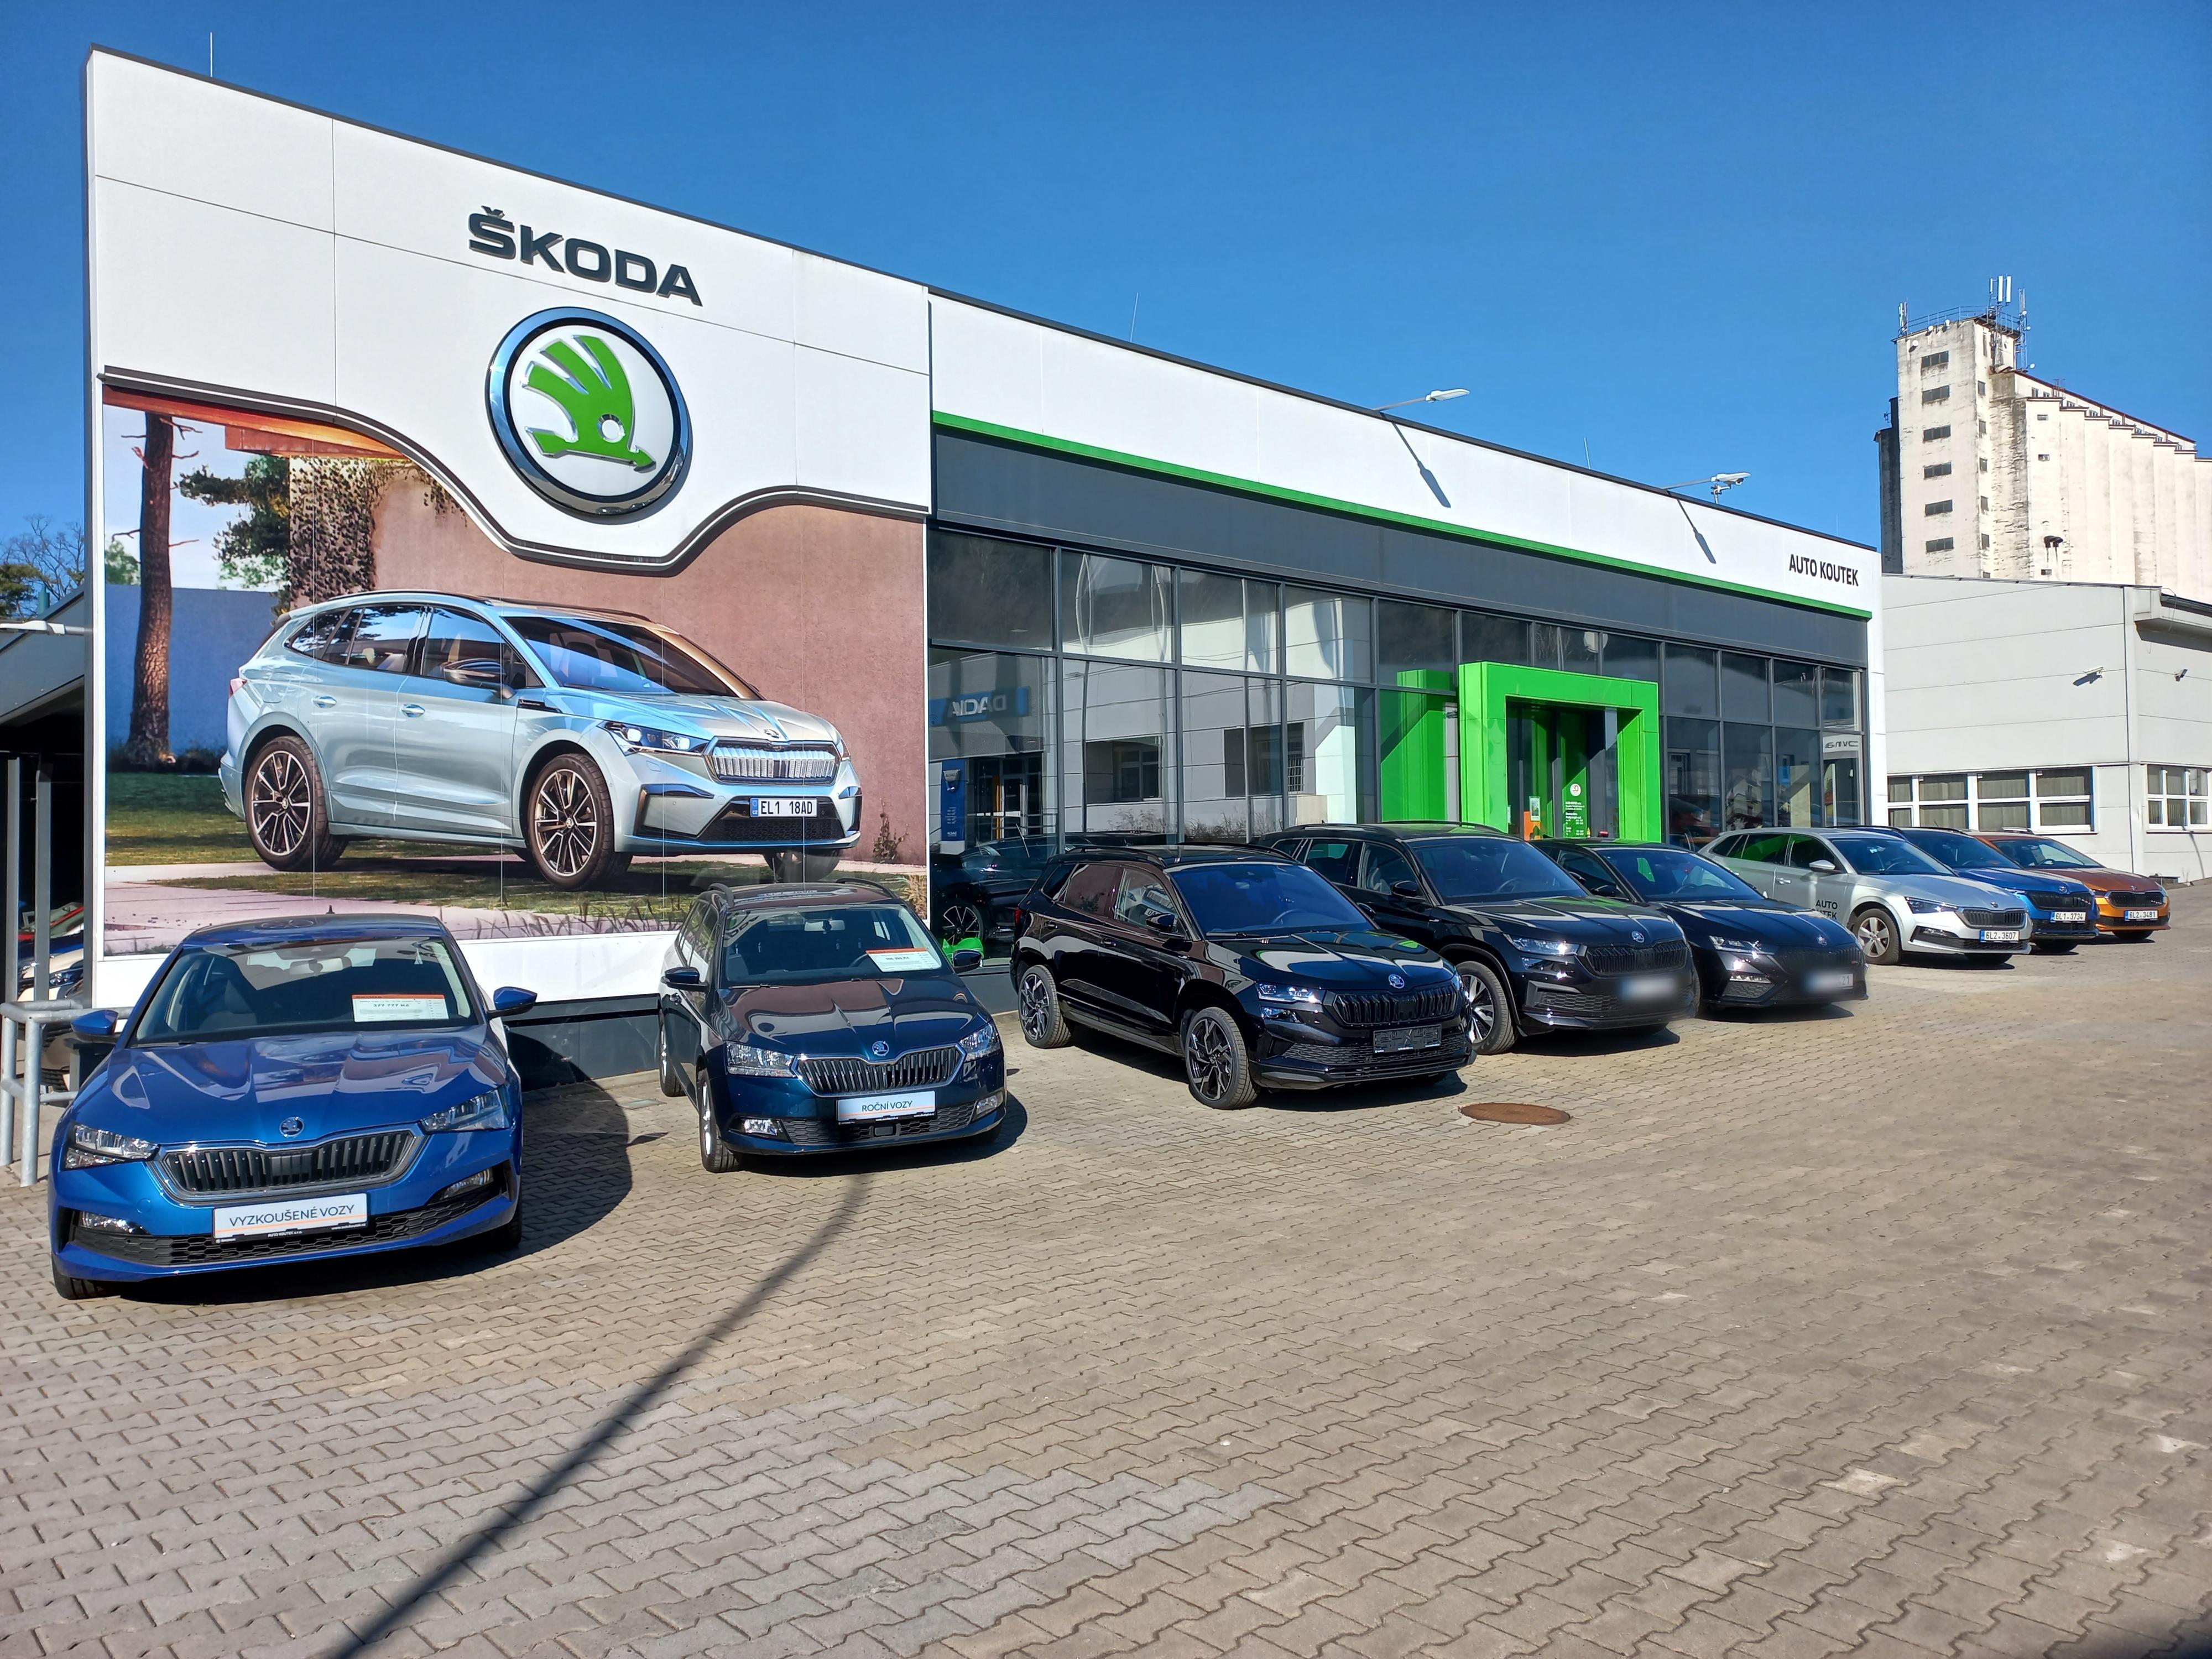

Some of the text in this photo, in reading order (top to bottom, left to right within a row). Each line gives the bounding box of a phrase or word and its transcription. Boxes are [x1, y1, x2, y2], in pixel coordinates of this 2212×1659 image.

[468, 205, 703, 306] ŠKODA
[1789, 554, 1859, 587] AUTO KOUTEK
[760, 801, 812, 815] EL1 18AD
[1815, 899, 1838, 910] AUTO
[862, 1100, 913, 1112] ROČNÍ VOZY
[229, 1204, 354, 1227] VYZKOUŠENÉ VOZY
